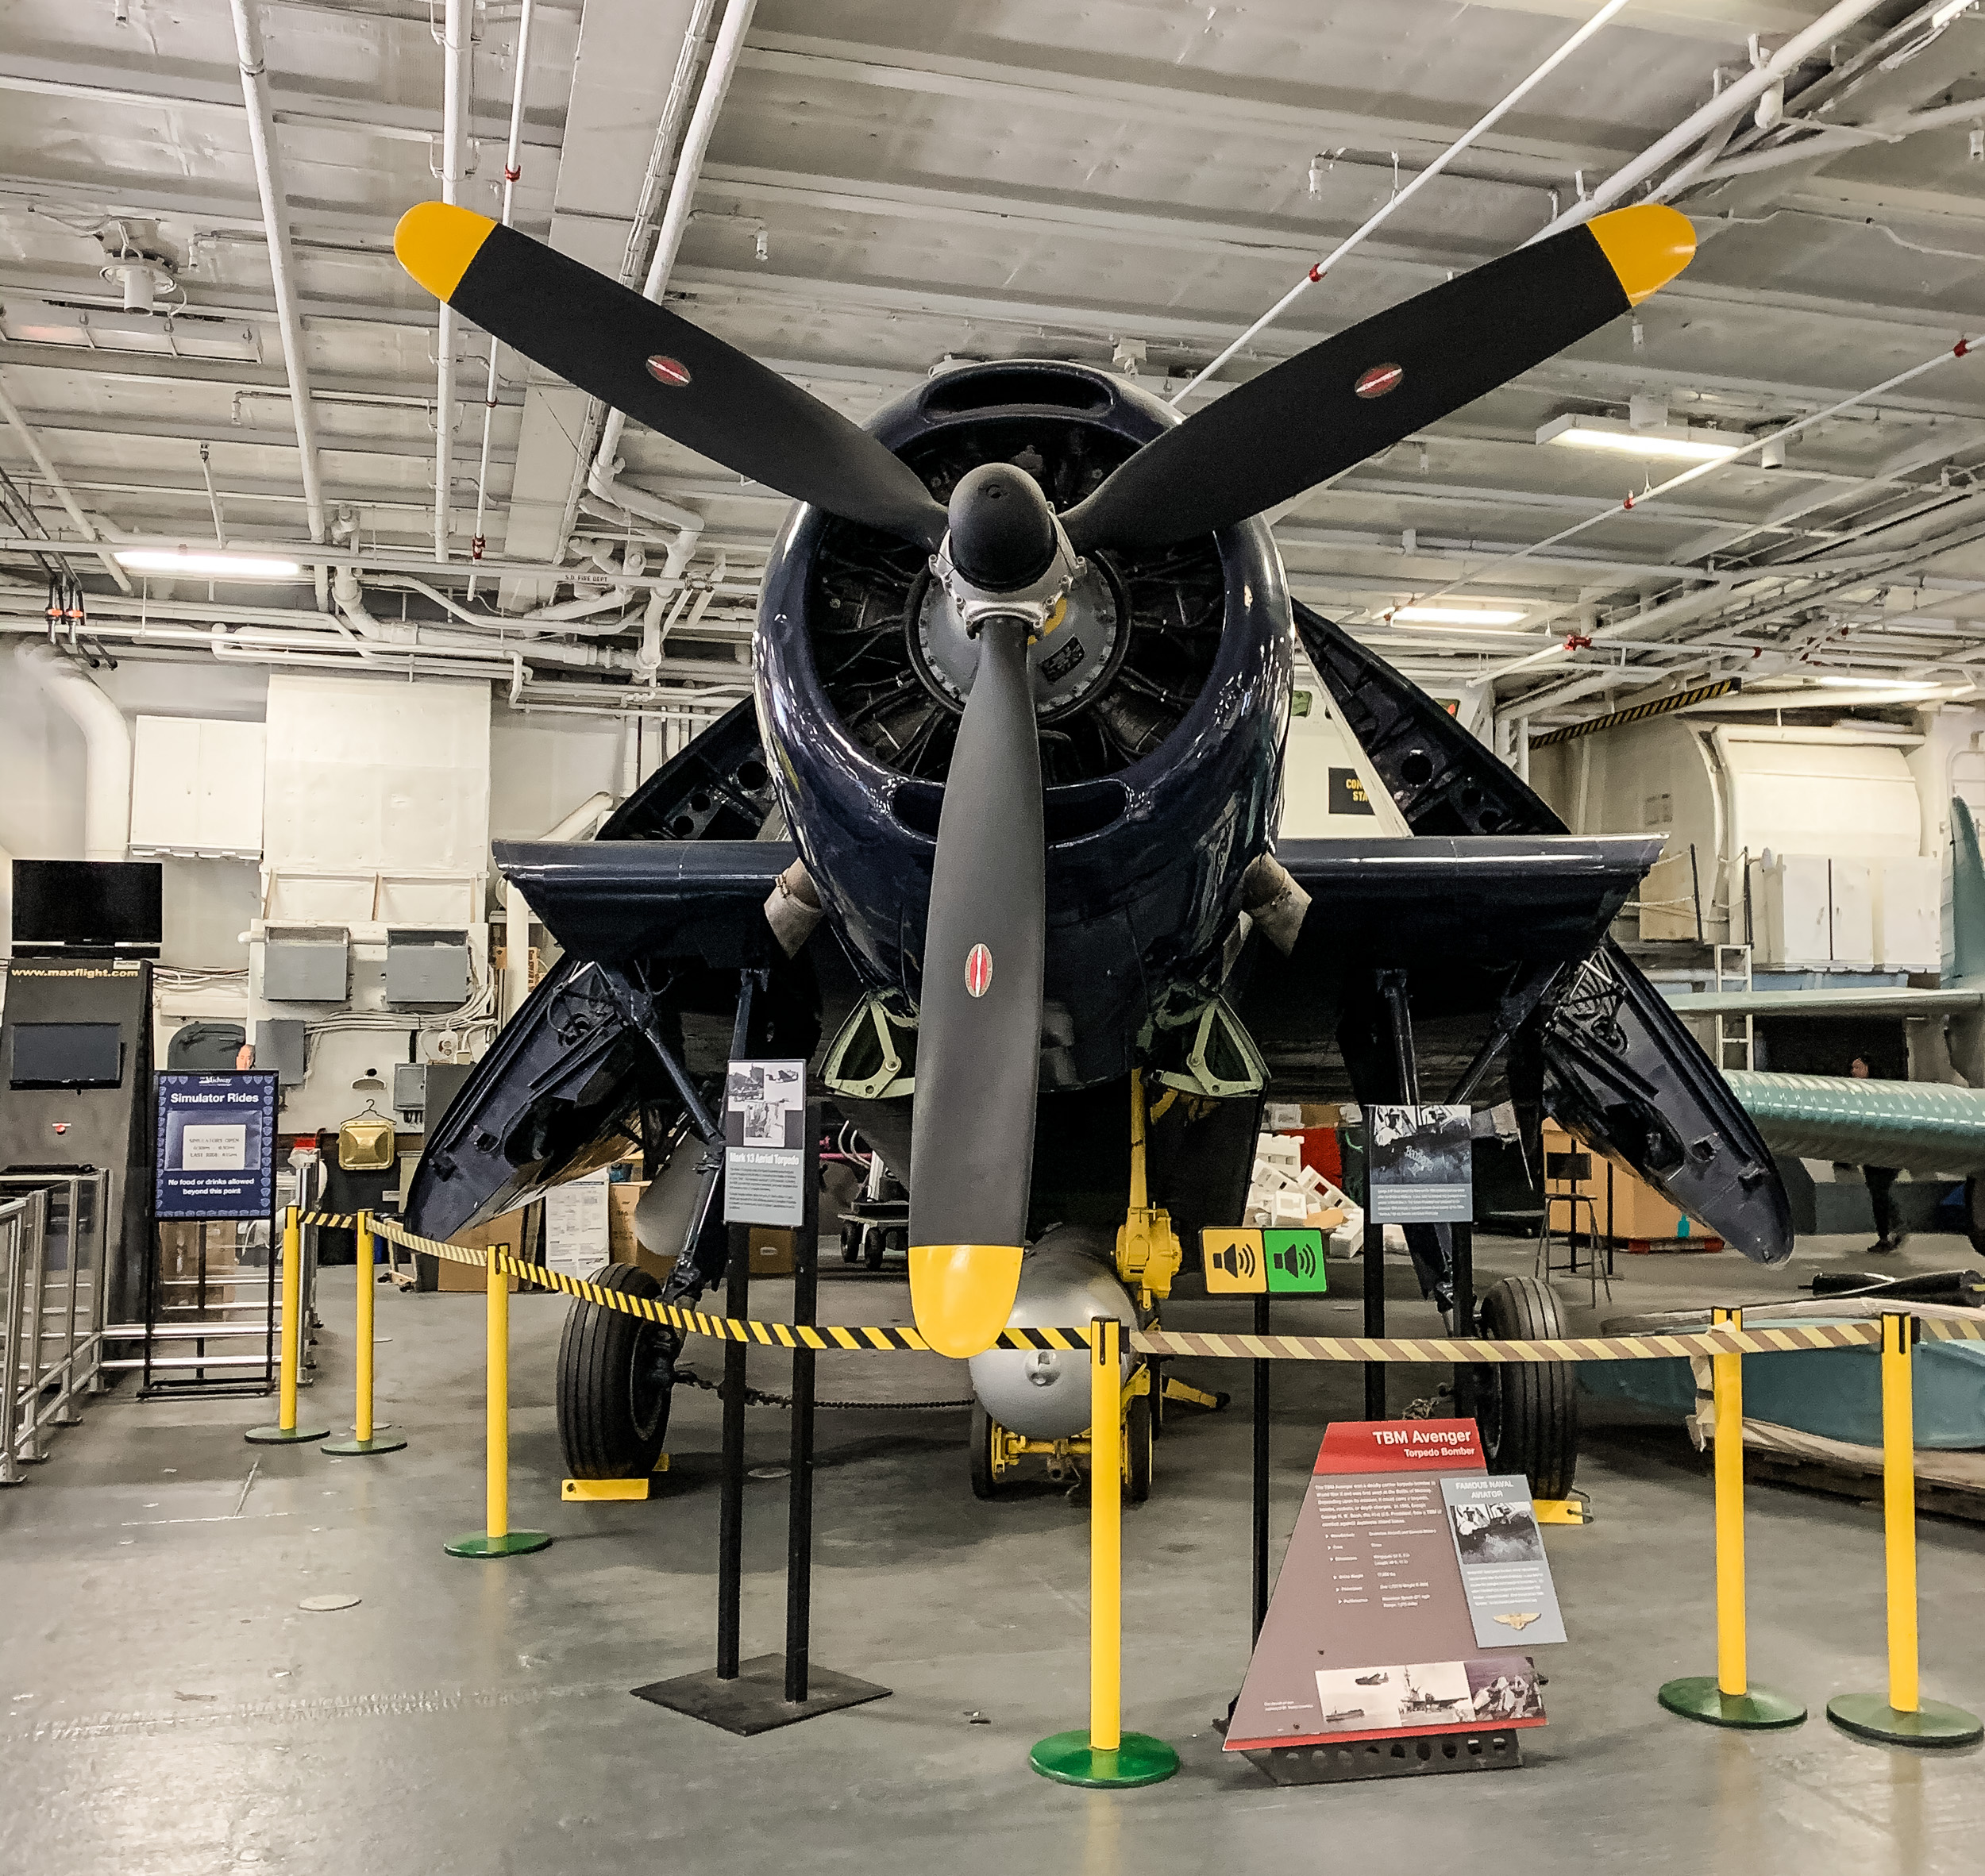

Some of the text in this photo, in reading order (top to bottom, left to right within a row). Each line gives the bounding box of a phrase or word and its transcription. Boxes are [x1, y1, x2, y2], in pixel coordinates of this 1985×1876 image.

[11, 968, 139, 979] www.maxflight.com
[170, 1093, 260, 1104] Simulator Rides
[730, 1152, 800, 1166] Mark 13 Aerial Torpedo
[1372, 1430, 1471, 1446] TBM Avenger
[1404, 1446, 1475, 1458] Torpedo Bomber
[1455, 1480, 1513, 1490] FAMOUS NAVAL
